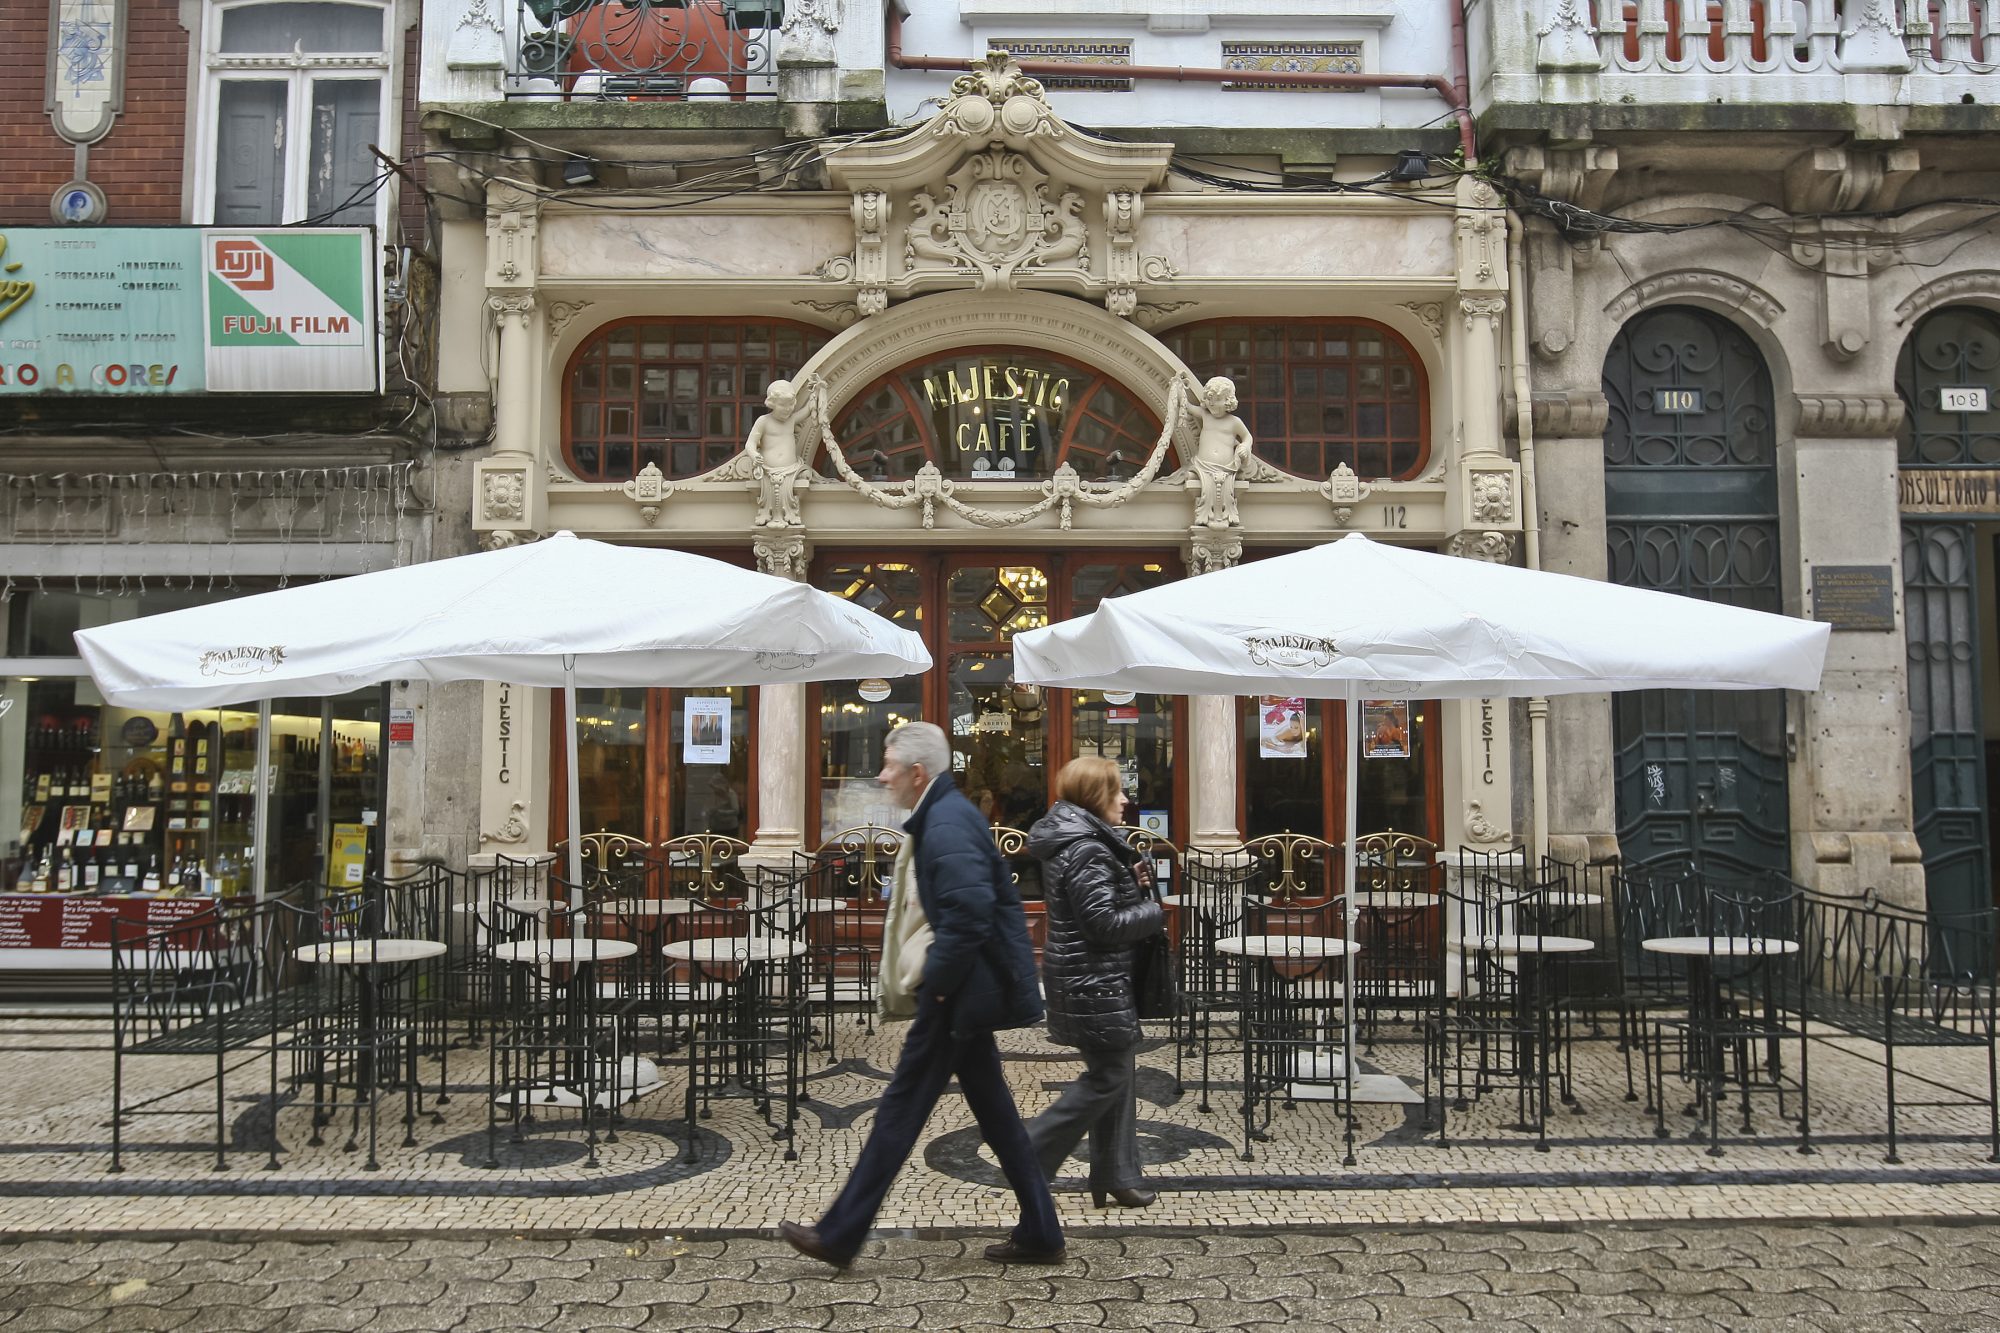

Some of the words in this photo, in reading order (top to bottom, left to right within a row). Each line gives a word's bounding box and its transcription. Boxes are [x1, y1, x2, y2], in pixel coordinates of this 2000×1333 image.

[121, 262, 184, 271] INDUSTRIAL
[216, 241, 266, 280] FUJI
[54, 271, 117, 280] FOTOGRAFIA
[121, 282, 182, 291] COMERCIAL
[55, 302, 122, 311] REPORTAGEM
[223, 315, 283, 335] FUJI
[289, 316, 350, 334] FILM
[55, 363, 75, 386] A
[923, 365, 1070, 411] MAJESTIC
[1664, 391, 1693, 409] 110
[1949, 392, 1979, 407] 108
[1899, 477, 1988, 505] ONSULTORIO
[1384, 506, 1407, 529] 112
[1259, 635, 1319, 653] MAJESTIC
[217, 646, 268, 665] MAJESTIC
